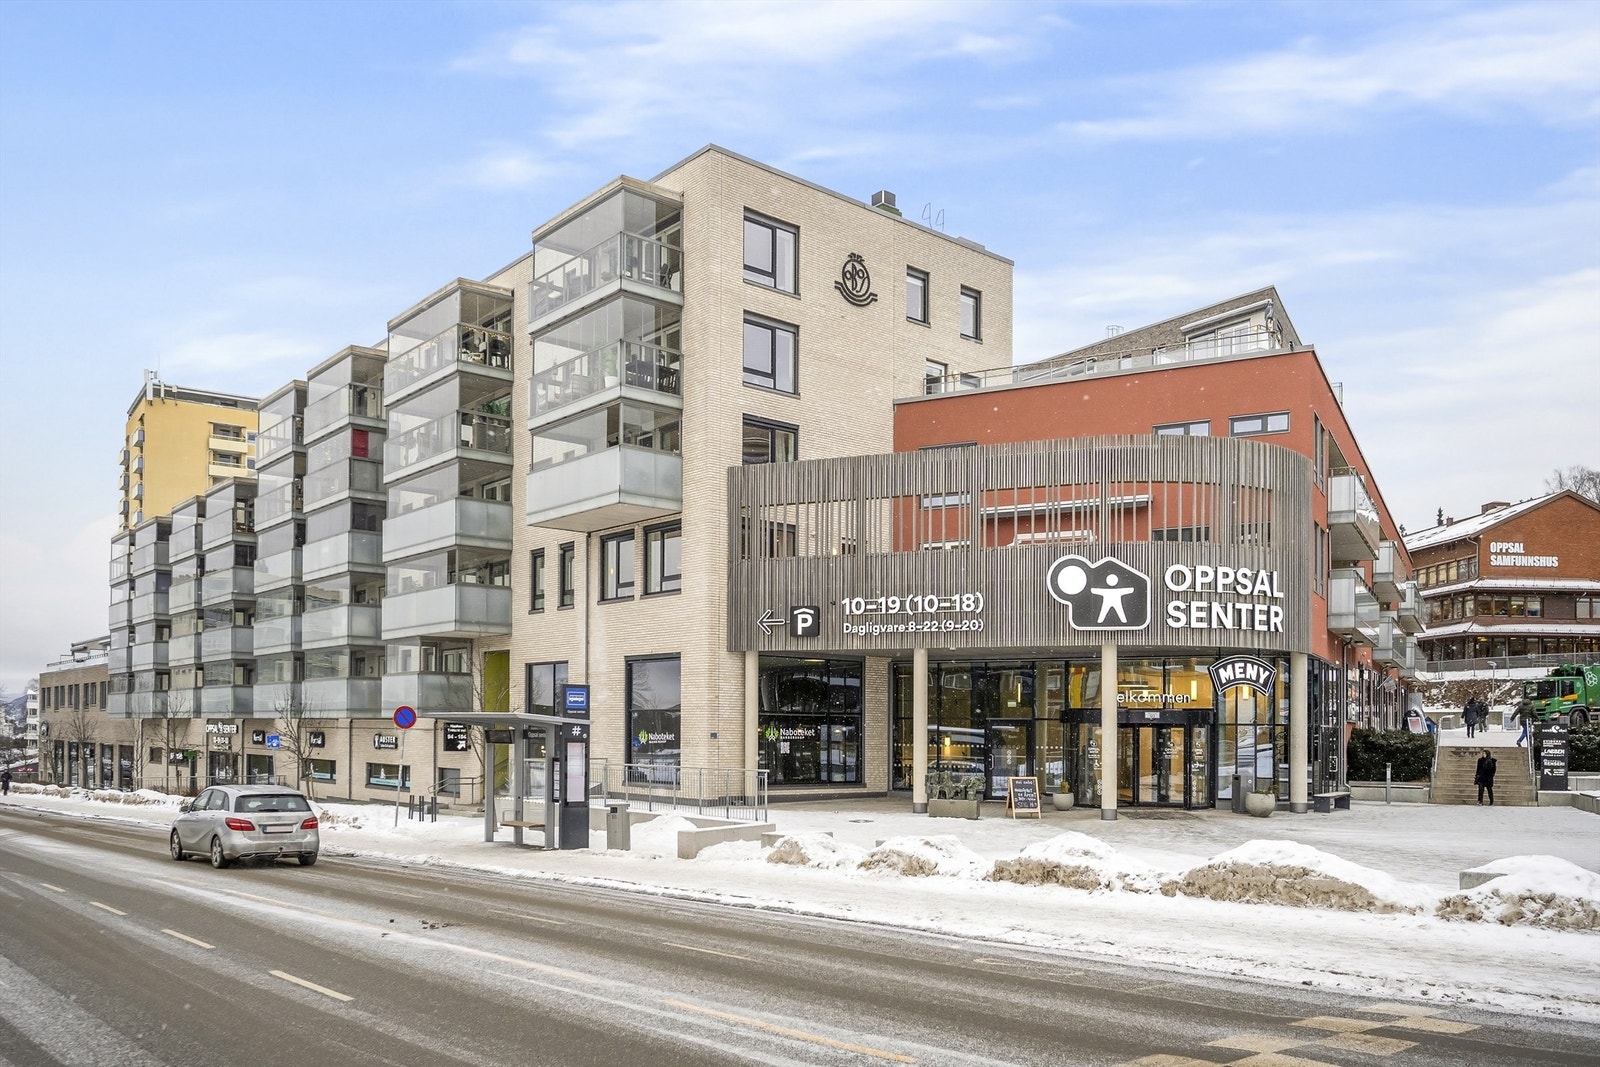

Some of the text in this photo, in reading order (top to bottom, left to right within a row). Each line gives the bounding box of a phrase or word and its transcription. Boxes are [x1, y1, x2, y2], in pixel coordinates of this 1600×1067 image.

[1490, 541, 1525, 553] OPPSAL
[1490, 554, 1559, 567] SAMFUNNSHUS
[1164, 564, 1284, 598] OPPSAL
[841, 596, 900, 615] 10-19
[797, 613, 813, 635] P
[1166, 600, 1284, 632] SENTER
[843, 621, 905, 636] Dagligvare
[909, 620, 938, 632] 8-22
[1218, 662, 1270, 684] MENY
[1116, 690, 1191, 704] elkommen
[648, 731, 675, 741] Naboteket
[780, 727, 816, 737] Naboteket
